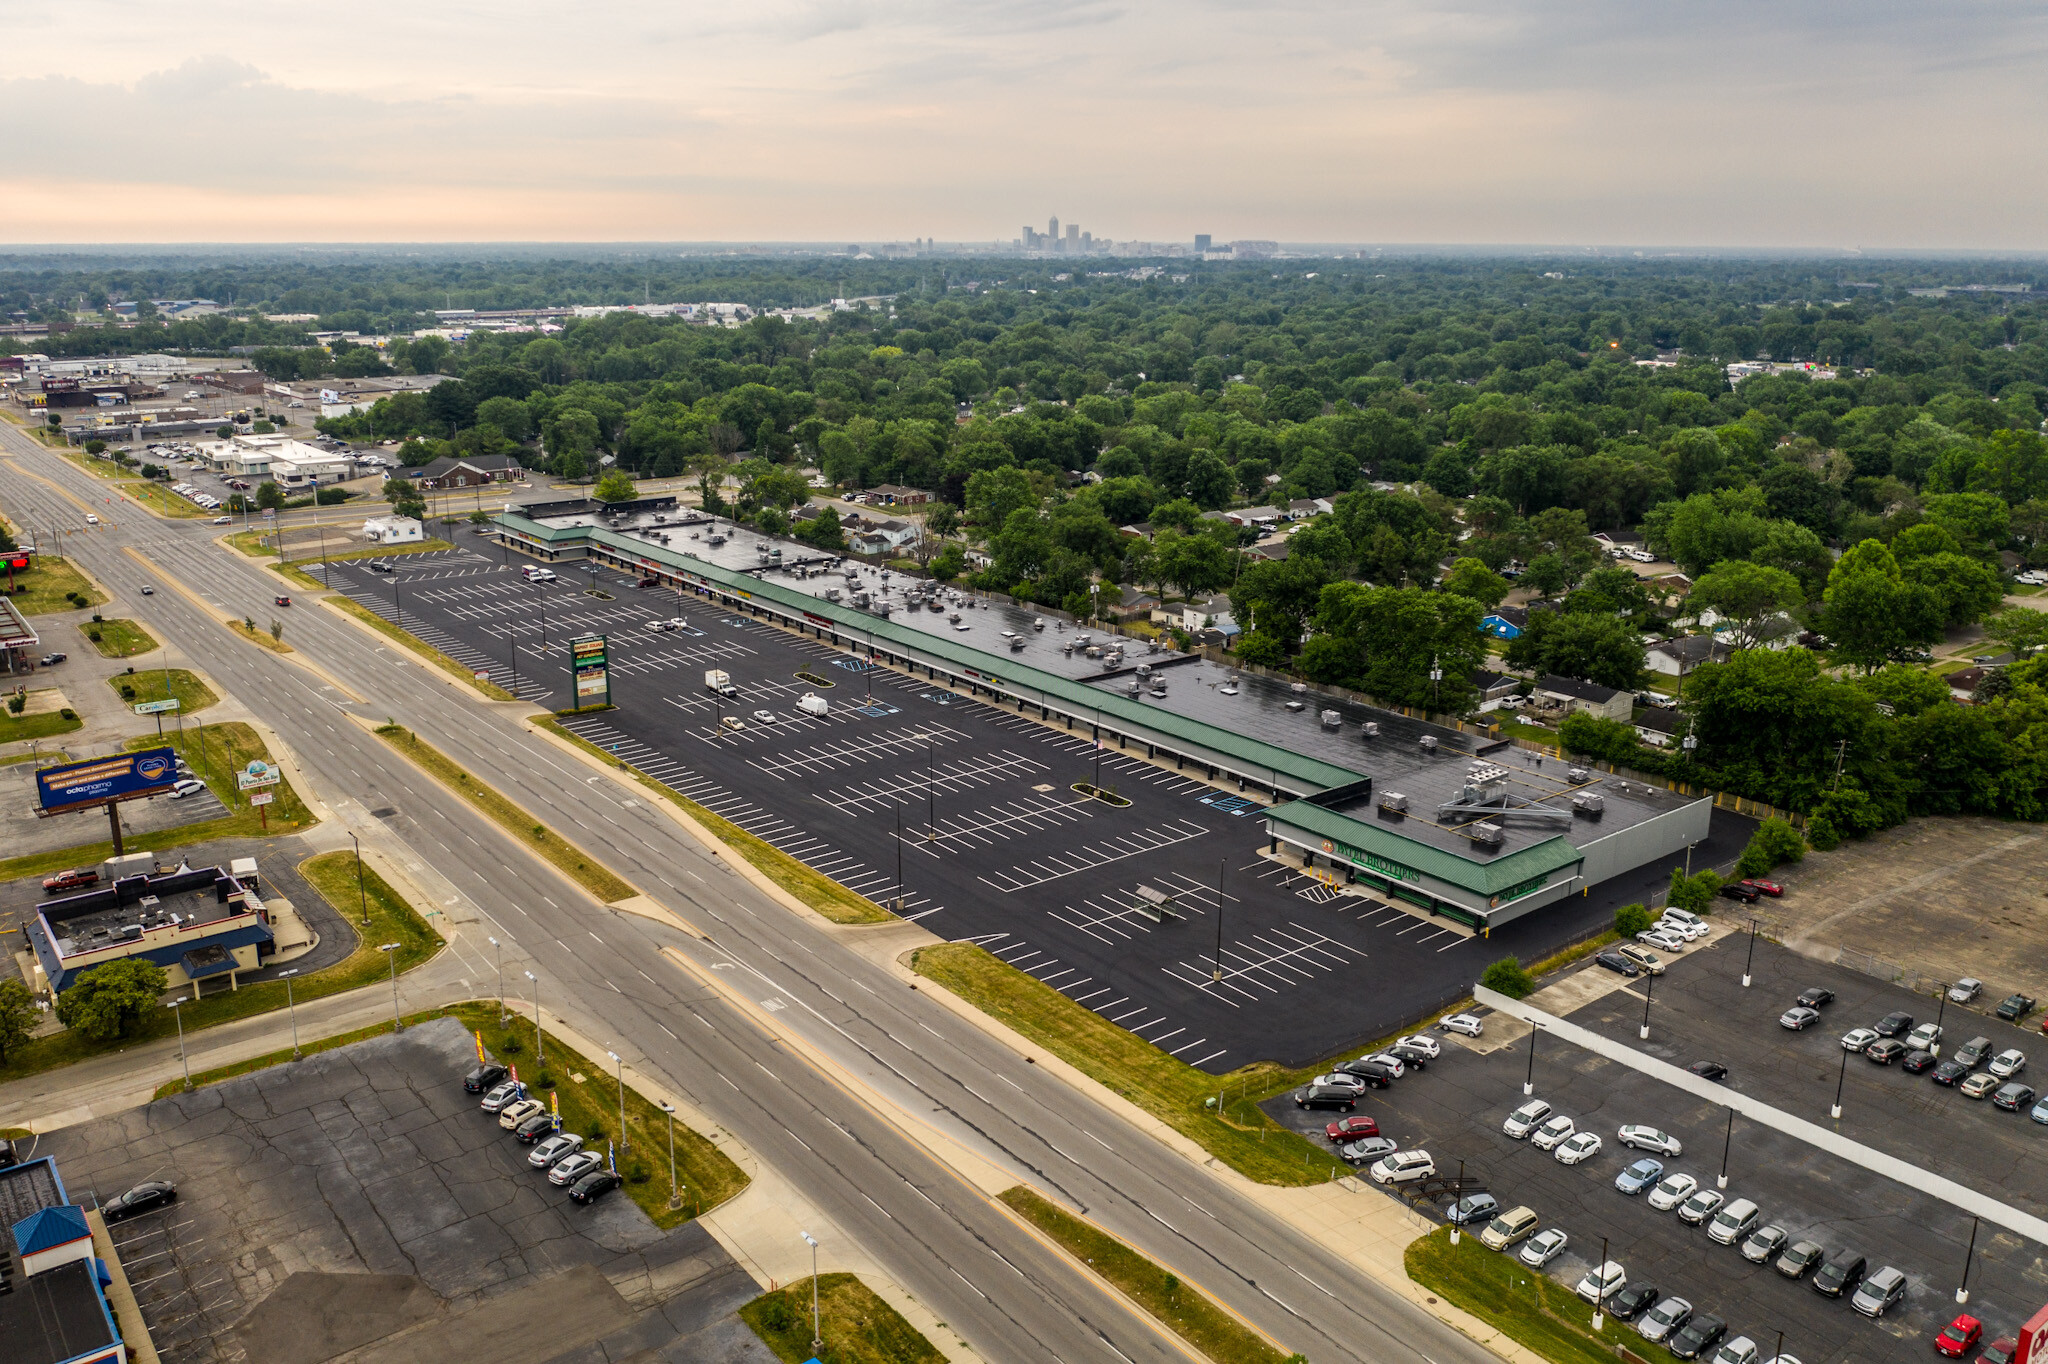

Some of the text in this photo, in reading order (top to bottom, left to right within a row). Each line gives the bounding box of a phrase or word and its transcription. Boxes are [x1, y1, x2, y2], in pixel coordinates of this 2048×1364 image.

[5, 640, 37, 648] Speedway
[66, 781, 112, 795] octapharma
[1336, 843, 1361, 860] PATEL
[1366, 853, 1420, 883] BROTHERS
